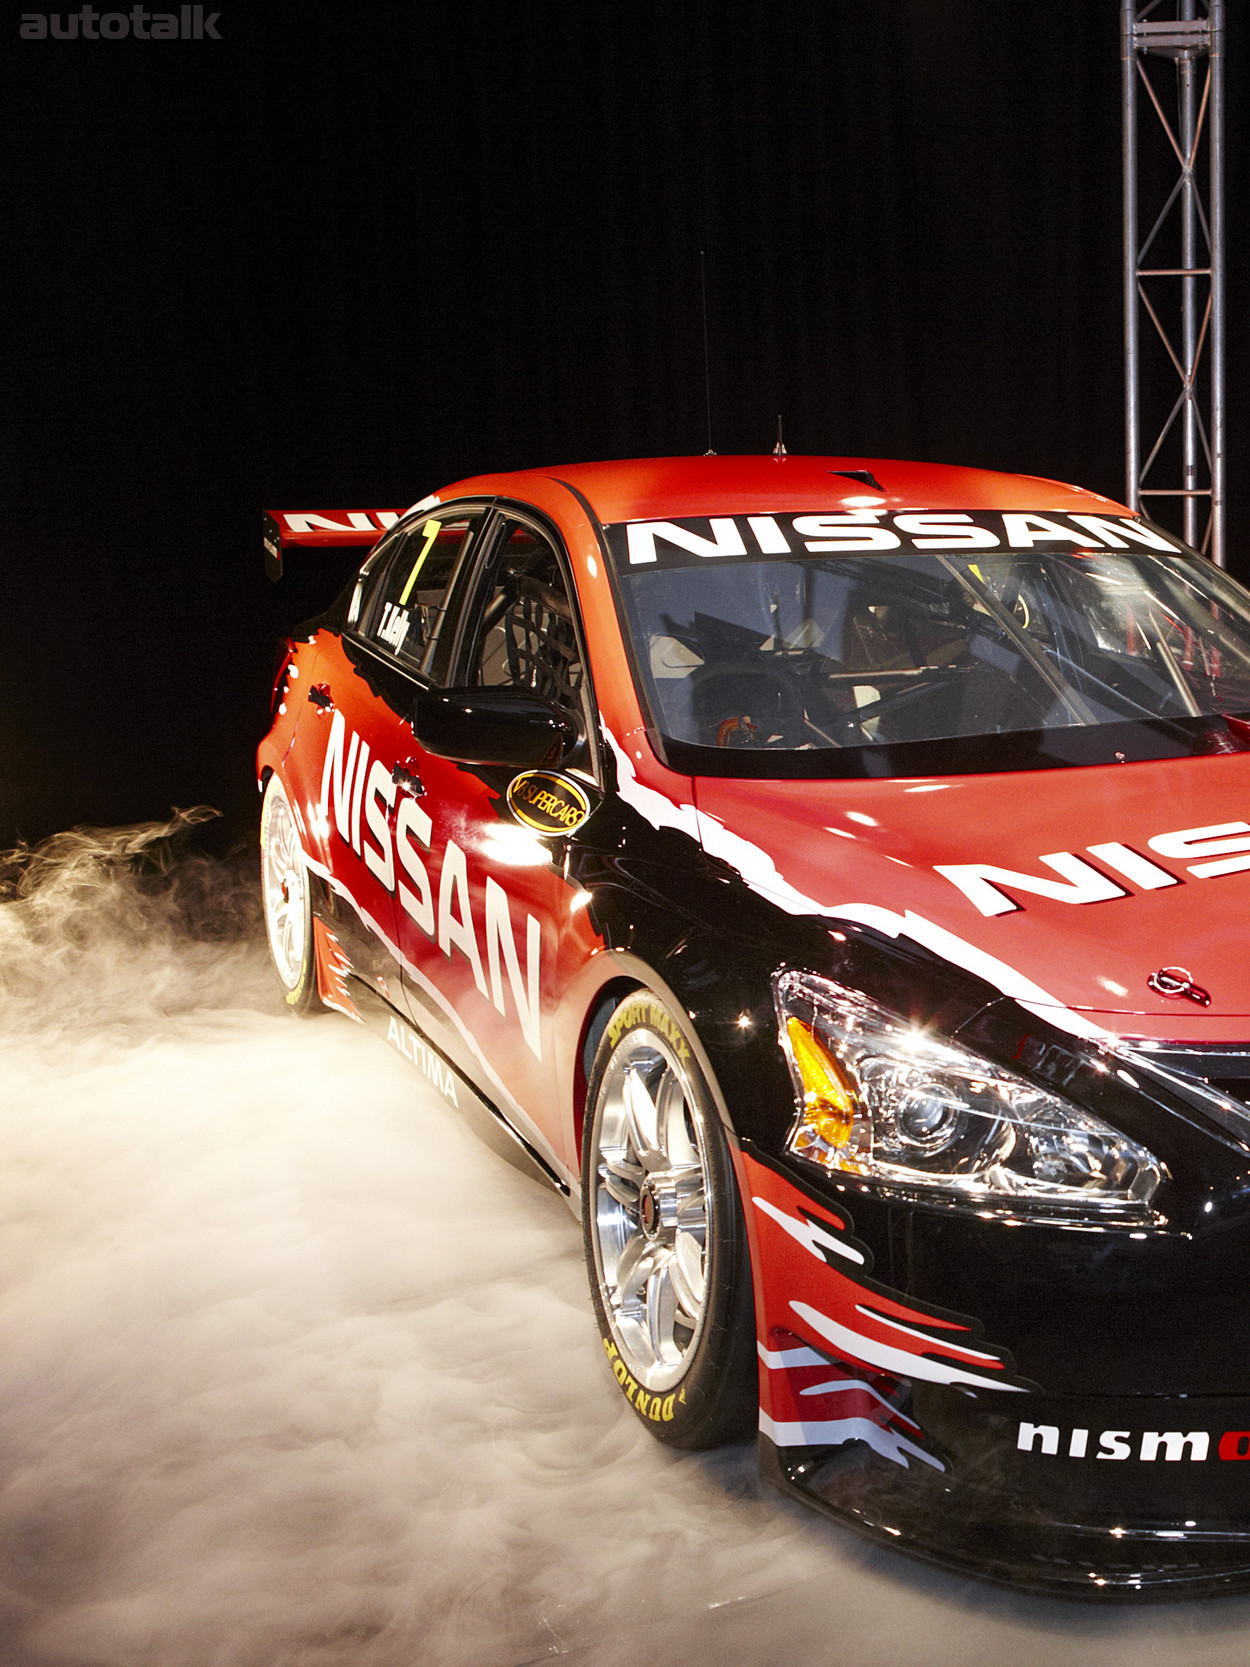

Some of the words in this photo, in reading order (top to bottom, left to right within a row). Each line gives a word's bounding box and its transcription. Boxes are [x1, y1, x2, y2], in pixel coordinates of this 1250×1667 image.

[398, 519, 442, 606] 7
[626, 512, 1182, 566] NISSAN
[320, 708, 542, 1062] NISSAN
[387, 1015, 459, 1109] ALTIMA
[608, 1003, 648, 1048] SPORT
[650, 1003, 690, 1068] MAXX
[603, 1337, 676, 1422] DUNLOP
